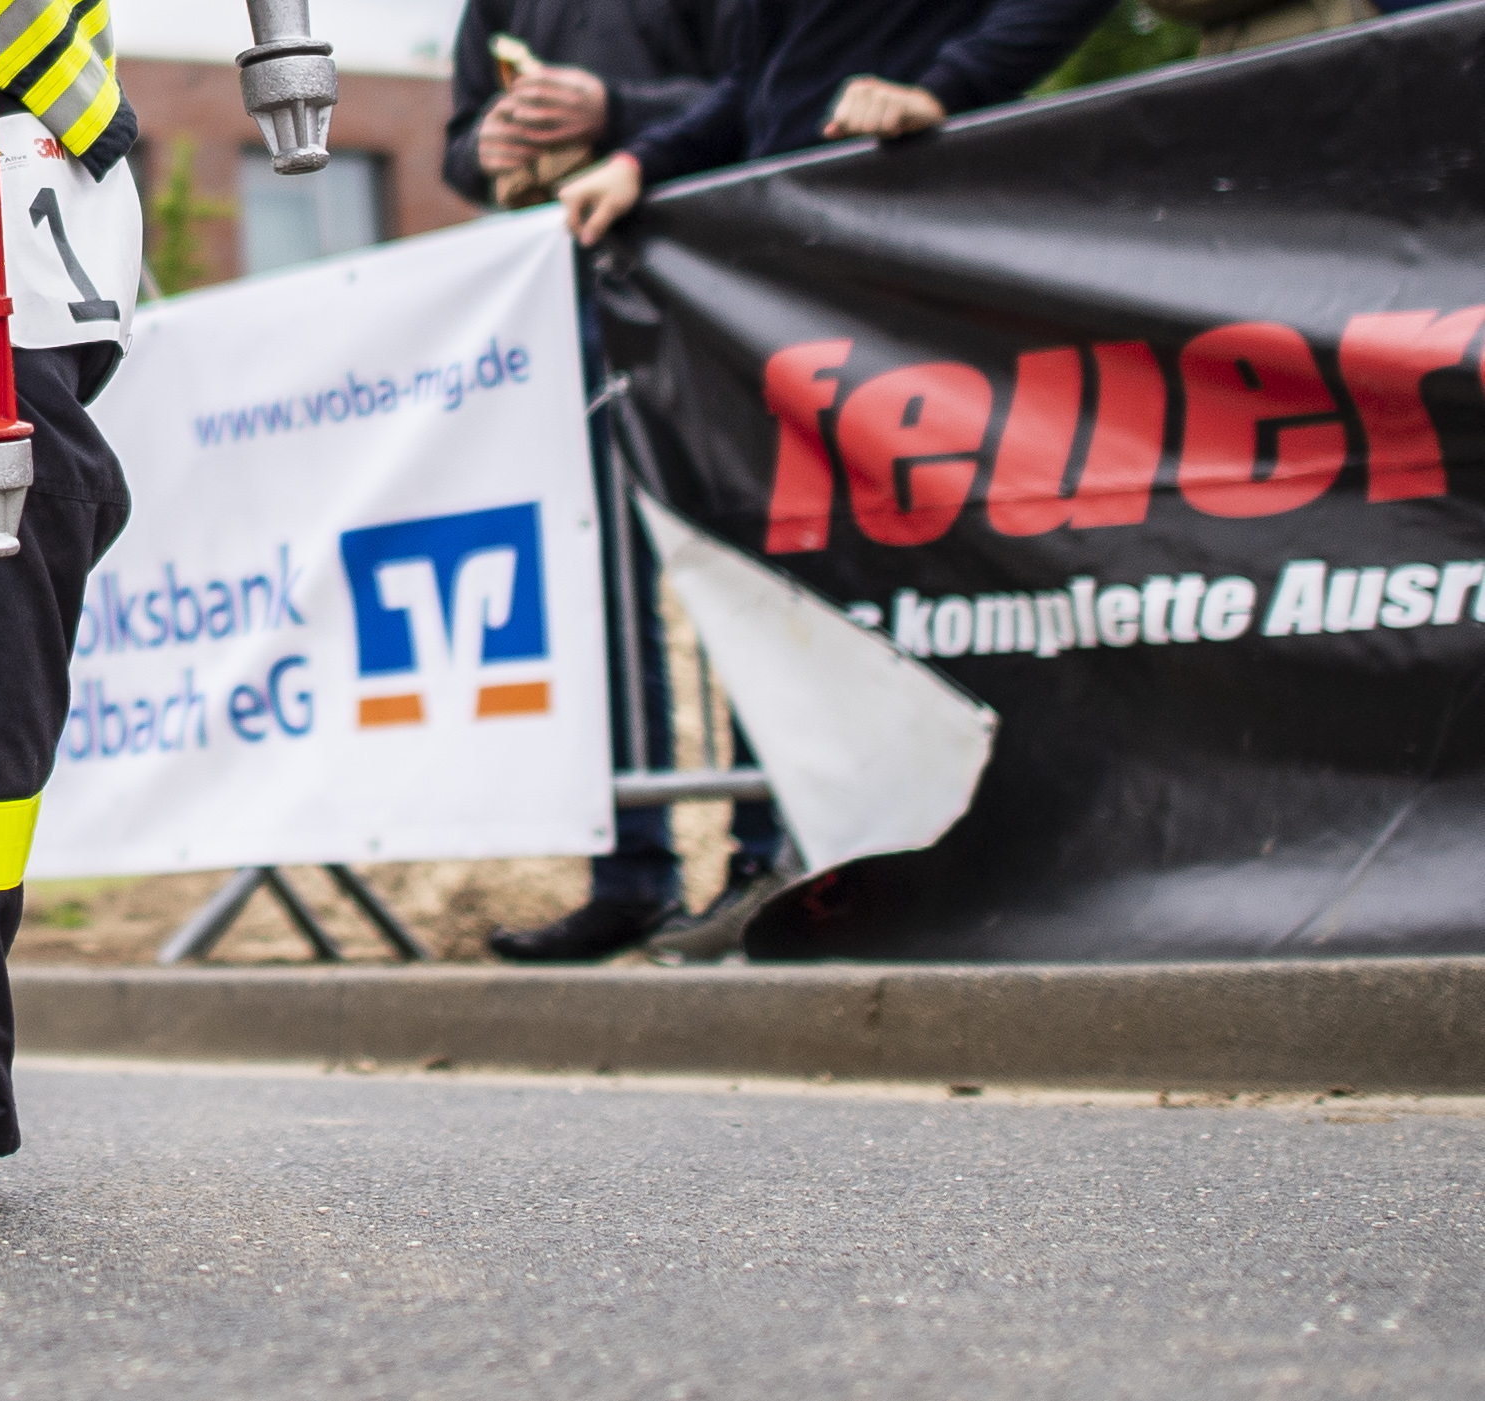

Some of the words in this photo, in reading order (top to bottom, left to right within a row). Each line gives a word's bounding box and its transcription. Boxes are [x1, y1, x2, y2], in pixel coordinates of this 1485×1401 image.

[34, 137, 66, 161] 3M
[28, 187, 122, 325] 1
[193, 333, 532, 447] www.voba-mg.de
[762, 303, 1485, 555] feuer
[74, 542, 306, 659] olksbank
[892, 573, 1258, 658] komplette
[65, 667, 208, 763] dbach
[228, 654, 314, 744] eG
